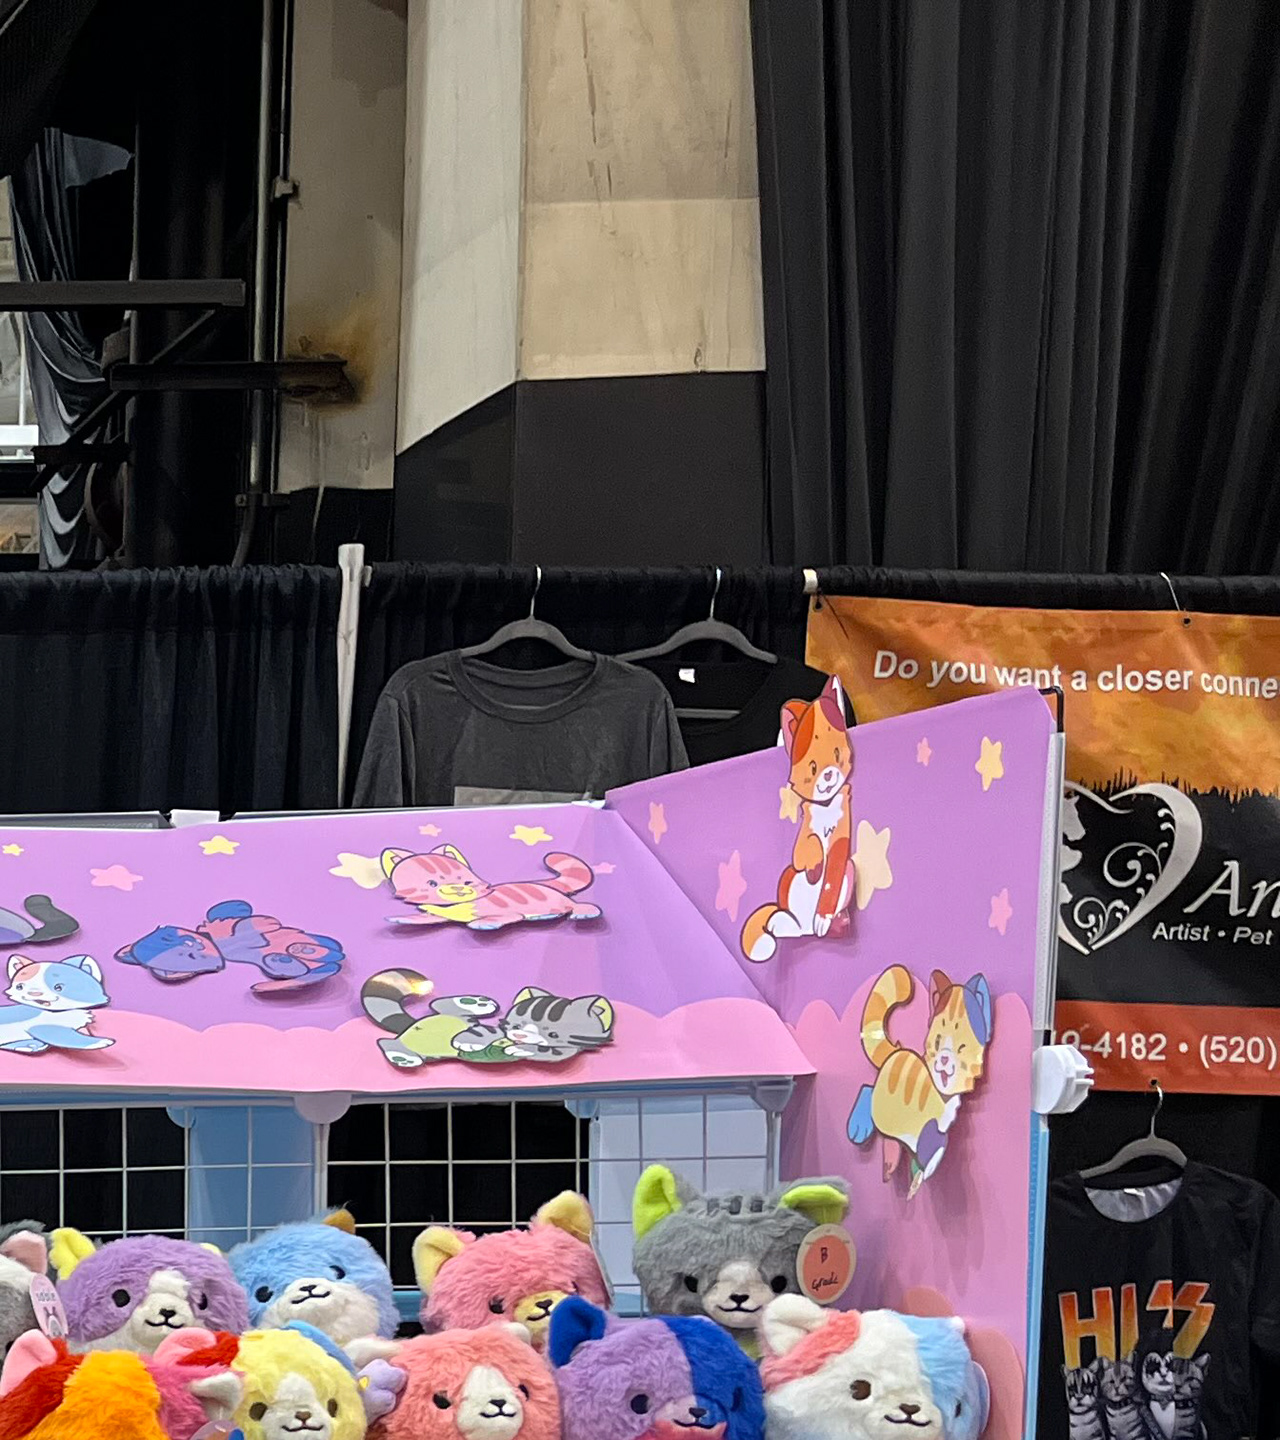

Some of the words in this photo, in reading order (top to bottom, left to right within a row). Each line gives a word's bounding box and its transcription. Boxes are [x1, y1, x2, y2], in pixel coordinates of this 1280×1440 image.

[873, 650, 919, 679] Do
[927, 659, 986, 688] you
[994, 664, 1061, 690] want
[1070, 670, 1088, 691] a
[1097, 663, 1195, 692] closer
[1152, 922, 1210, 942] Artist
[1233, 926, 1274, 945] Pet
[1199, 1034, 1278, 1071] (520)
[821, 1247, 827, 1263] B
